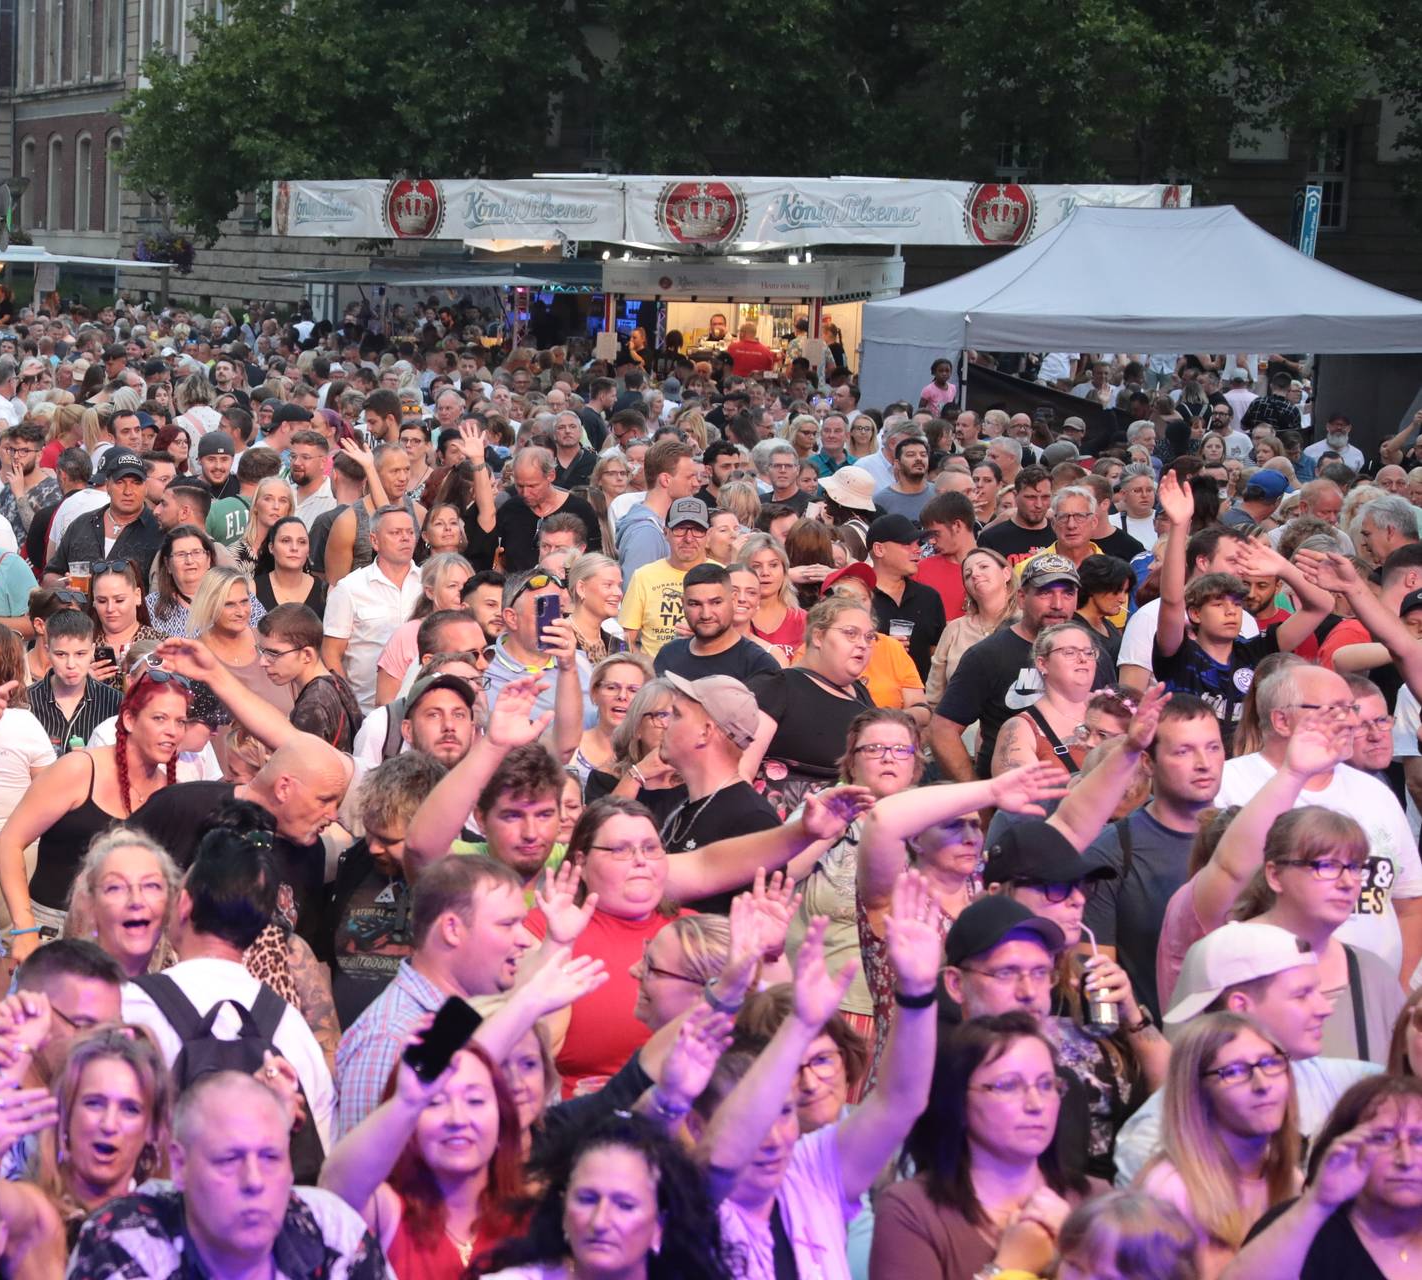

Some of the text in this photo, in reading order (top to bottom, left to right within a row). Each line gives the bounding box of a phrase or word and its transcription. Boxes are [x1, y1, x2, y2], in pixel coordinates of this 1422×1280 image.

[462, 191, 518, 223] König
[771, 193, 921, 227] König Pilsener
